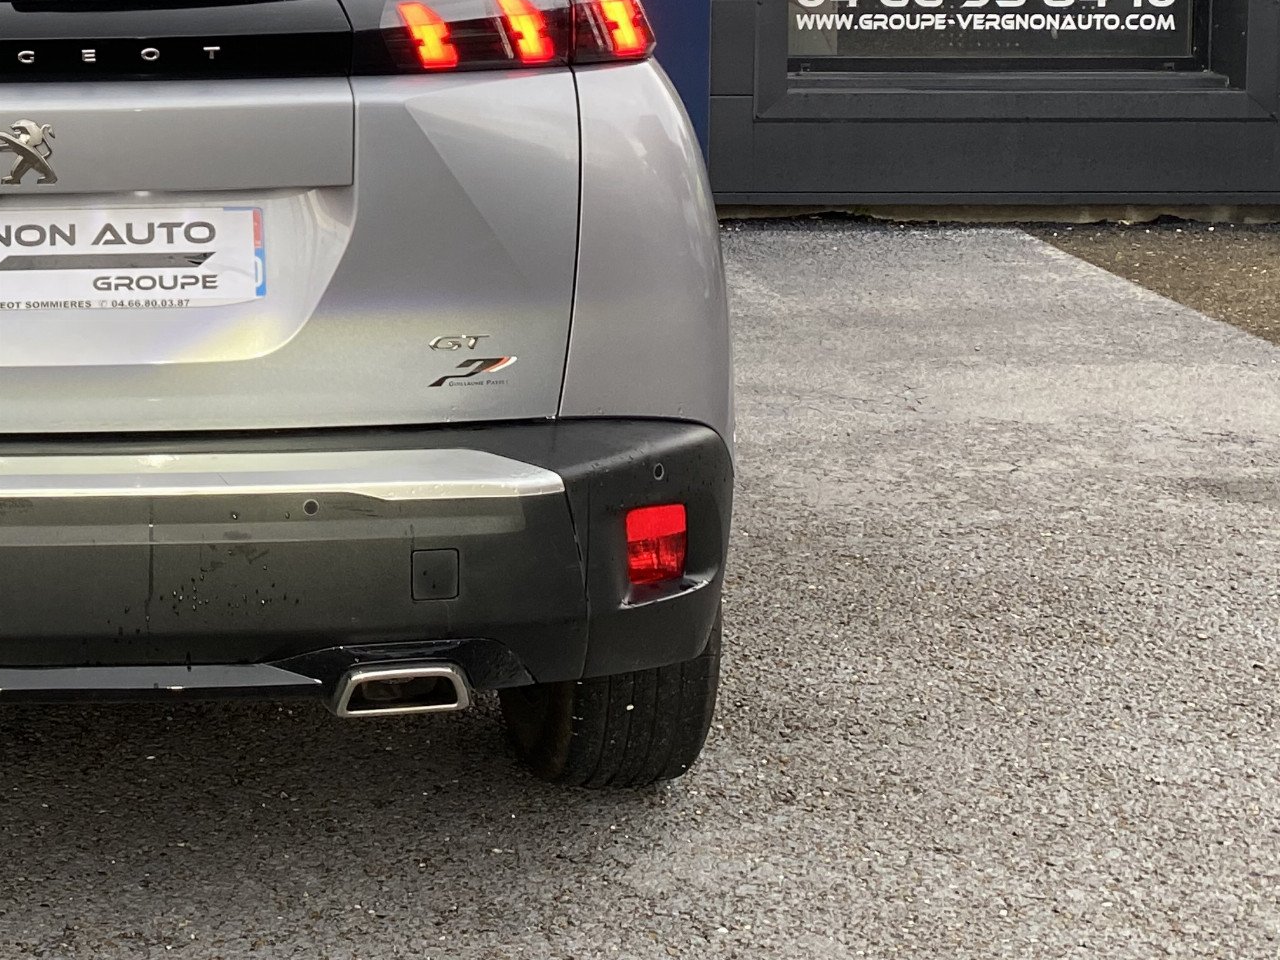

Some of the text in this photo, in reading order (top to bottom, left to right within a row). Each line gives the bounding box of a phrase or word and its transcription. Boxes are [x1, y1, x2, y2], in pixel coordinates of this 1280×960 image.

[795, 13, 1177, 32] WWW.GROUPE-VERGNONAUTO.COM
[90, 220, 217, 246] AUTO
[92, 274, 219, 292] GROUPE
[25, 299, 93, 309] SOMMIERES
[428, 333, 491, 352] GT
